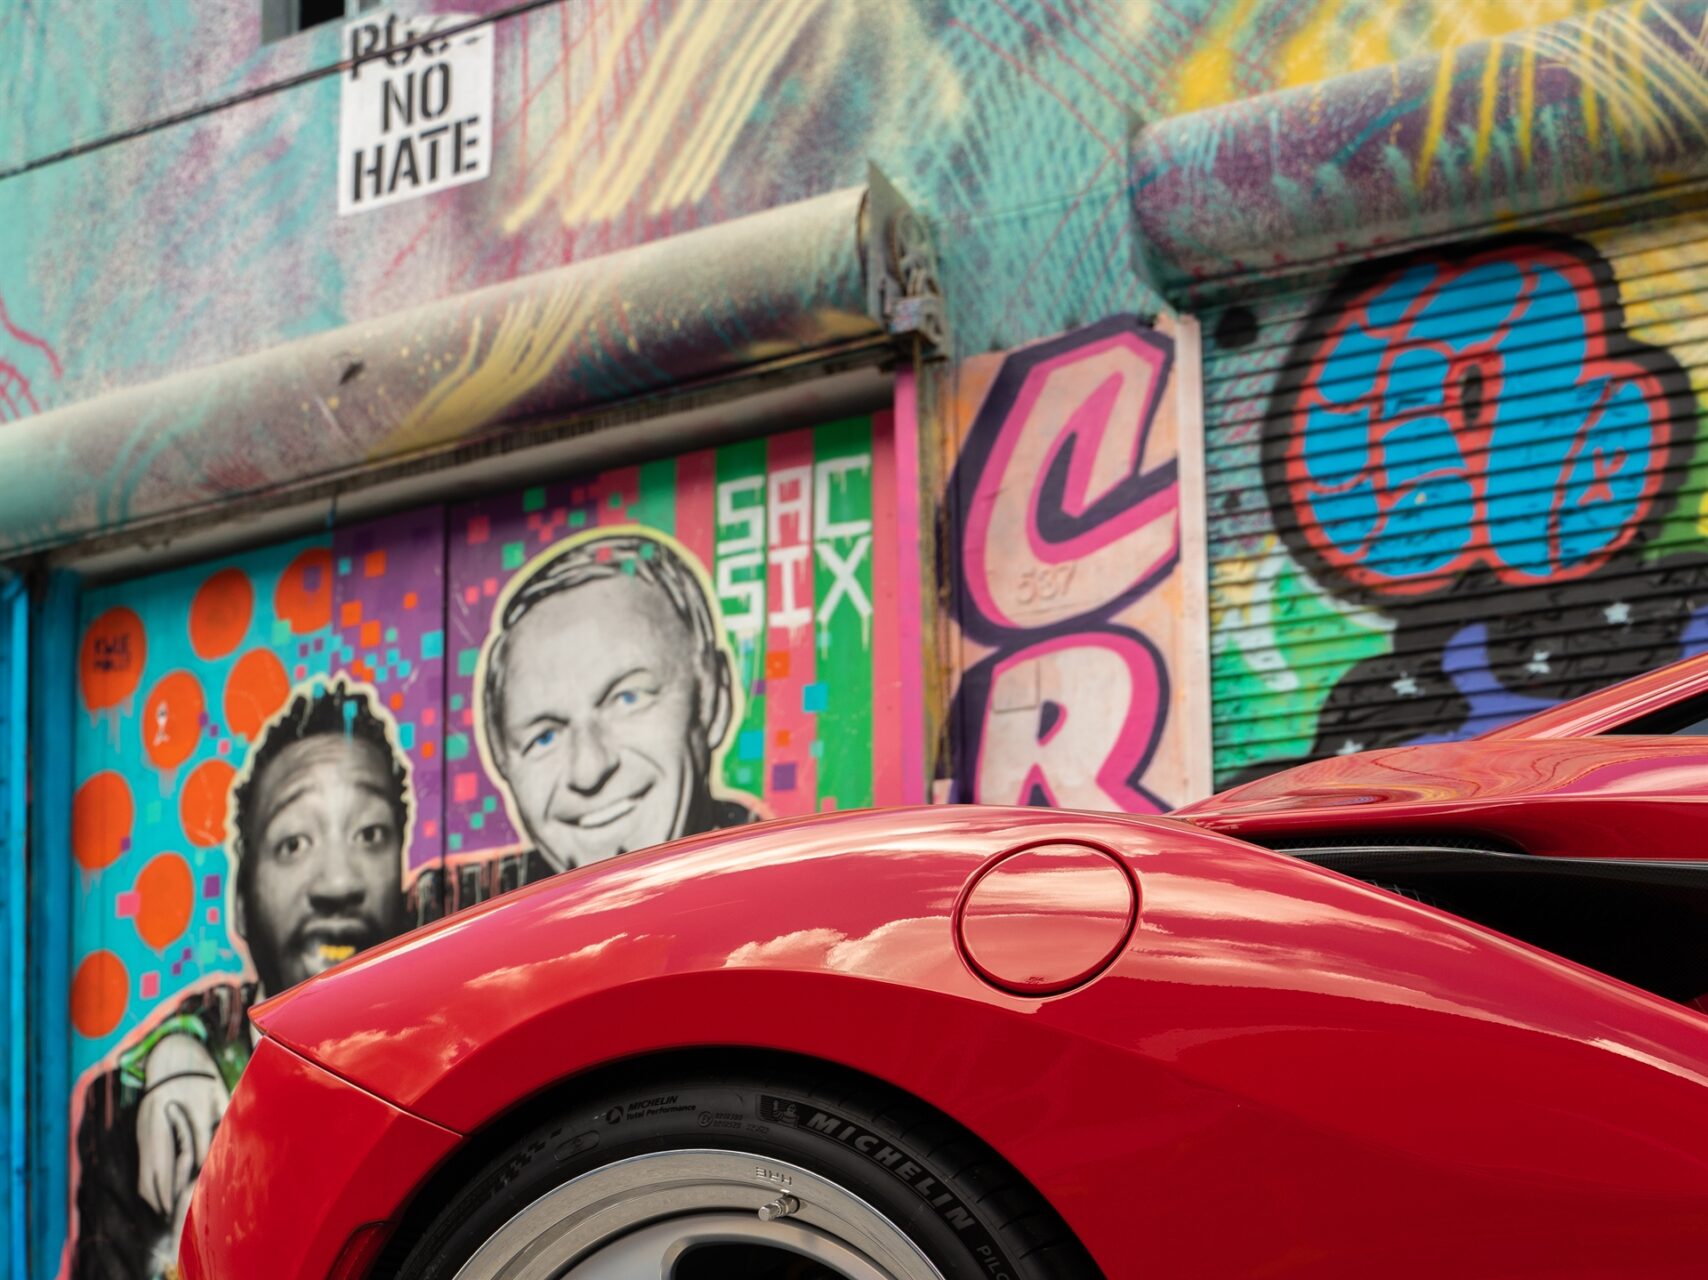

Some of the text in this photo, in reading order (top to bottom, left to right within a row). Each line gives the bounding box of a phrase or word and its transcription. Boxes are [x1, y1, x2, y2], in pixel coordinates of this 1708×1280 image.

[382, 62, 450, 134] NO
[353, 115, 479, 203] HATE
[716, 453, 872, 557] SAC
[716, 535, 874, 634] SIX
[628, 1095, 679, 1112] MICHELIN
[808, 1111, 976, 1232] MICHELIN
